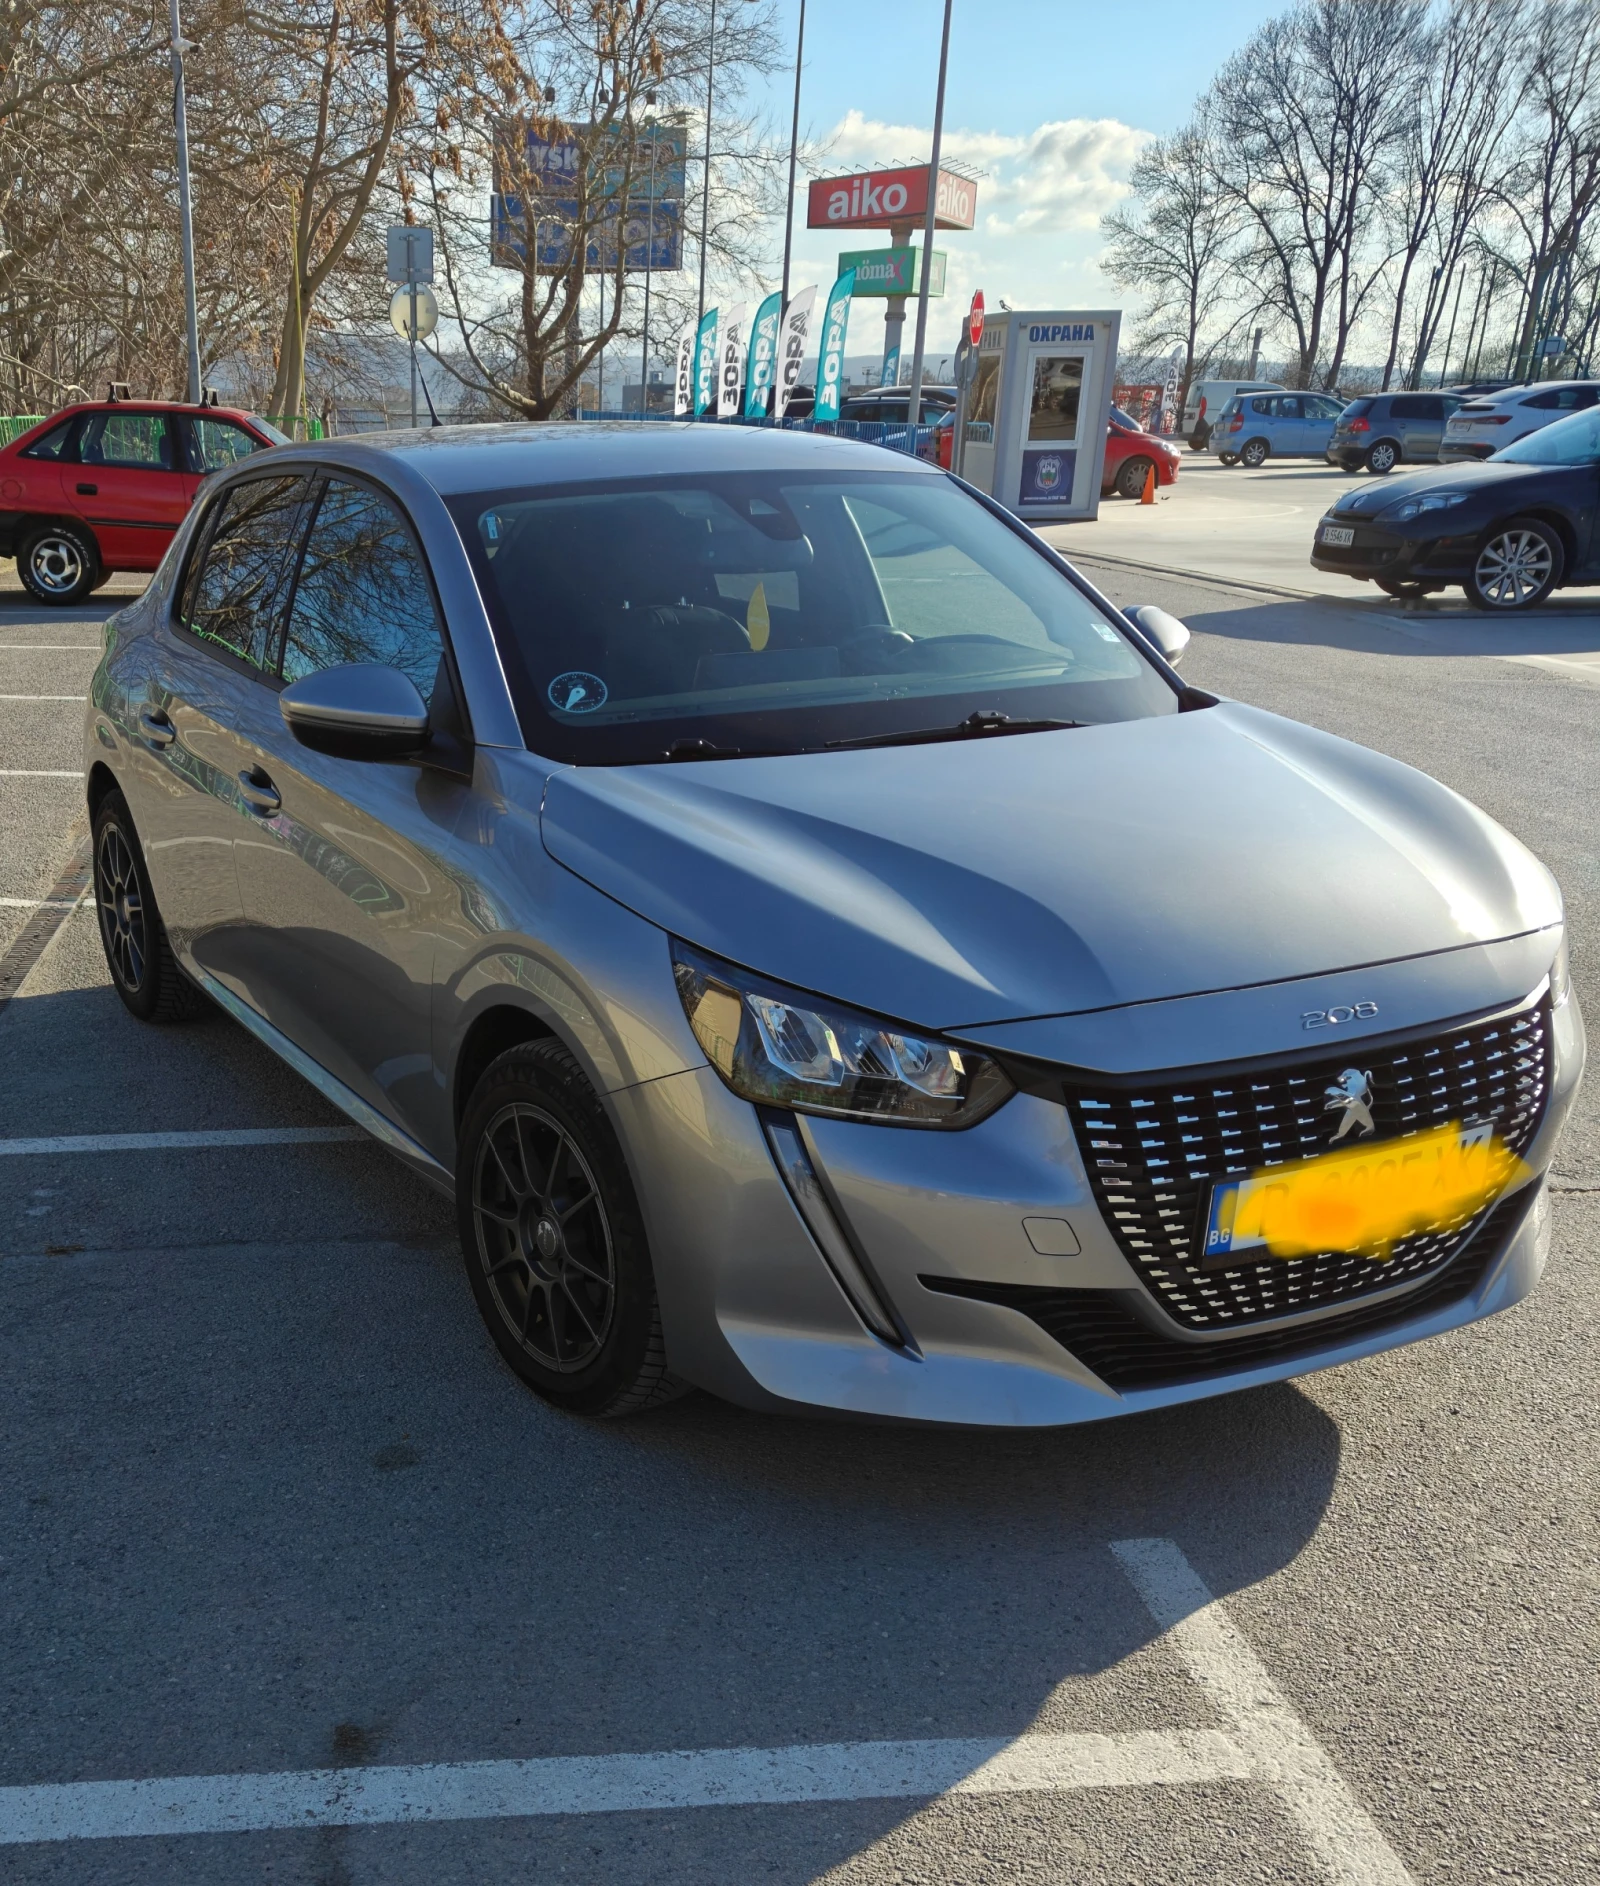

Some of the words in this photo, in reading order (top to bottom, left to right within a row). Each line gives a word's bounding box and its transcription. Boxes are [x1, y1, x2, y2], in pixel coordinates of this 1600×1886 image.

[827, 178, 908, 220] aiko
[936, 177, 969, 221] aiko
[971, 308, 984, 328] STOP
[1028, 324, 1095, 343] ОХРАНА
[677, 336, 692, 405] ЗОРА
[723, 321, 742, 407] ЗОРА
[751, 313, 778, 408] ЗОРА
[820, 293, 851, 410] ЗОРА
[1301, 1001, 1379, 1031] 208
[1208, 1227, 1231, 1247] BG
